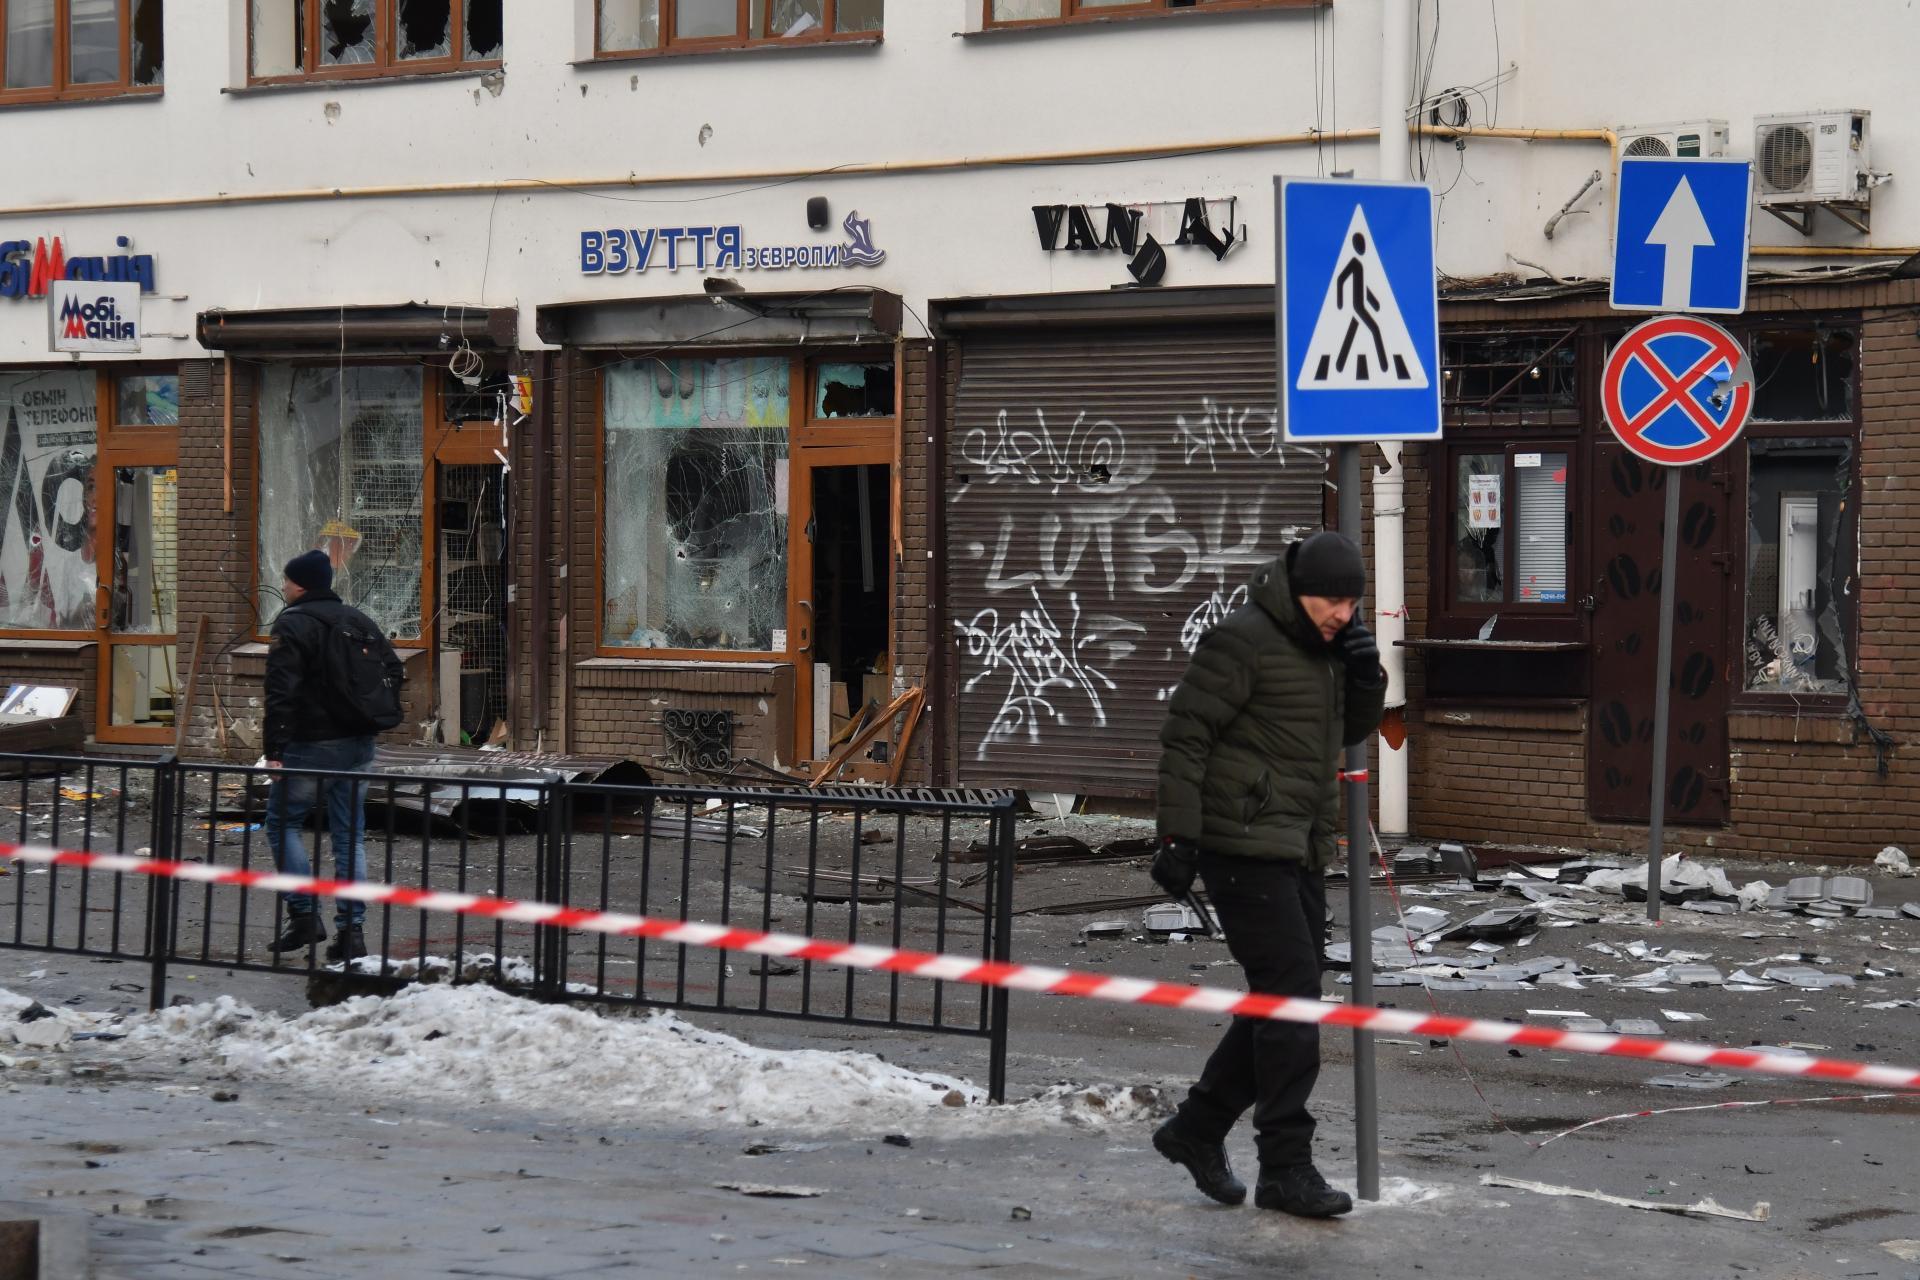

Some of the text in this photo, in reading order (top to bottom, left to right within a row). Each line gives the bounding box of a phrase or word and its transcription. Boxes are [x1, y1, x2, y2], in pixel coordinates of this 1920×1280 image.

[581, 226, 741, 274] ВЗУТТЯ
[60, 293, 115, 321] Мобі
[64, 314, 135, 340] Манія
[23, 389, 66, 407] ОБМІН
